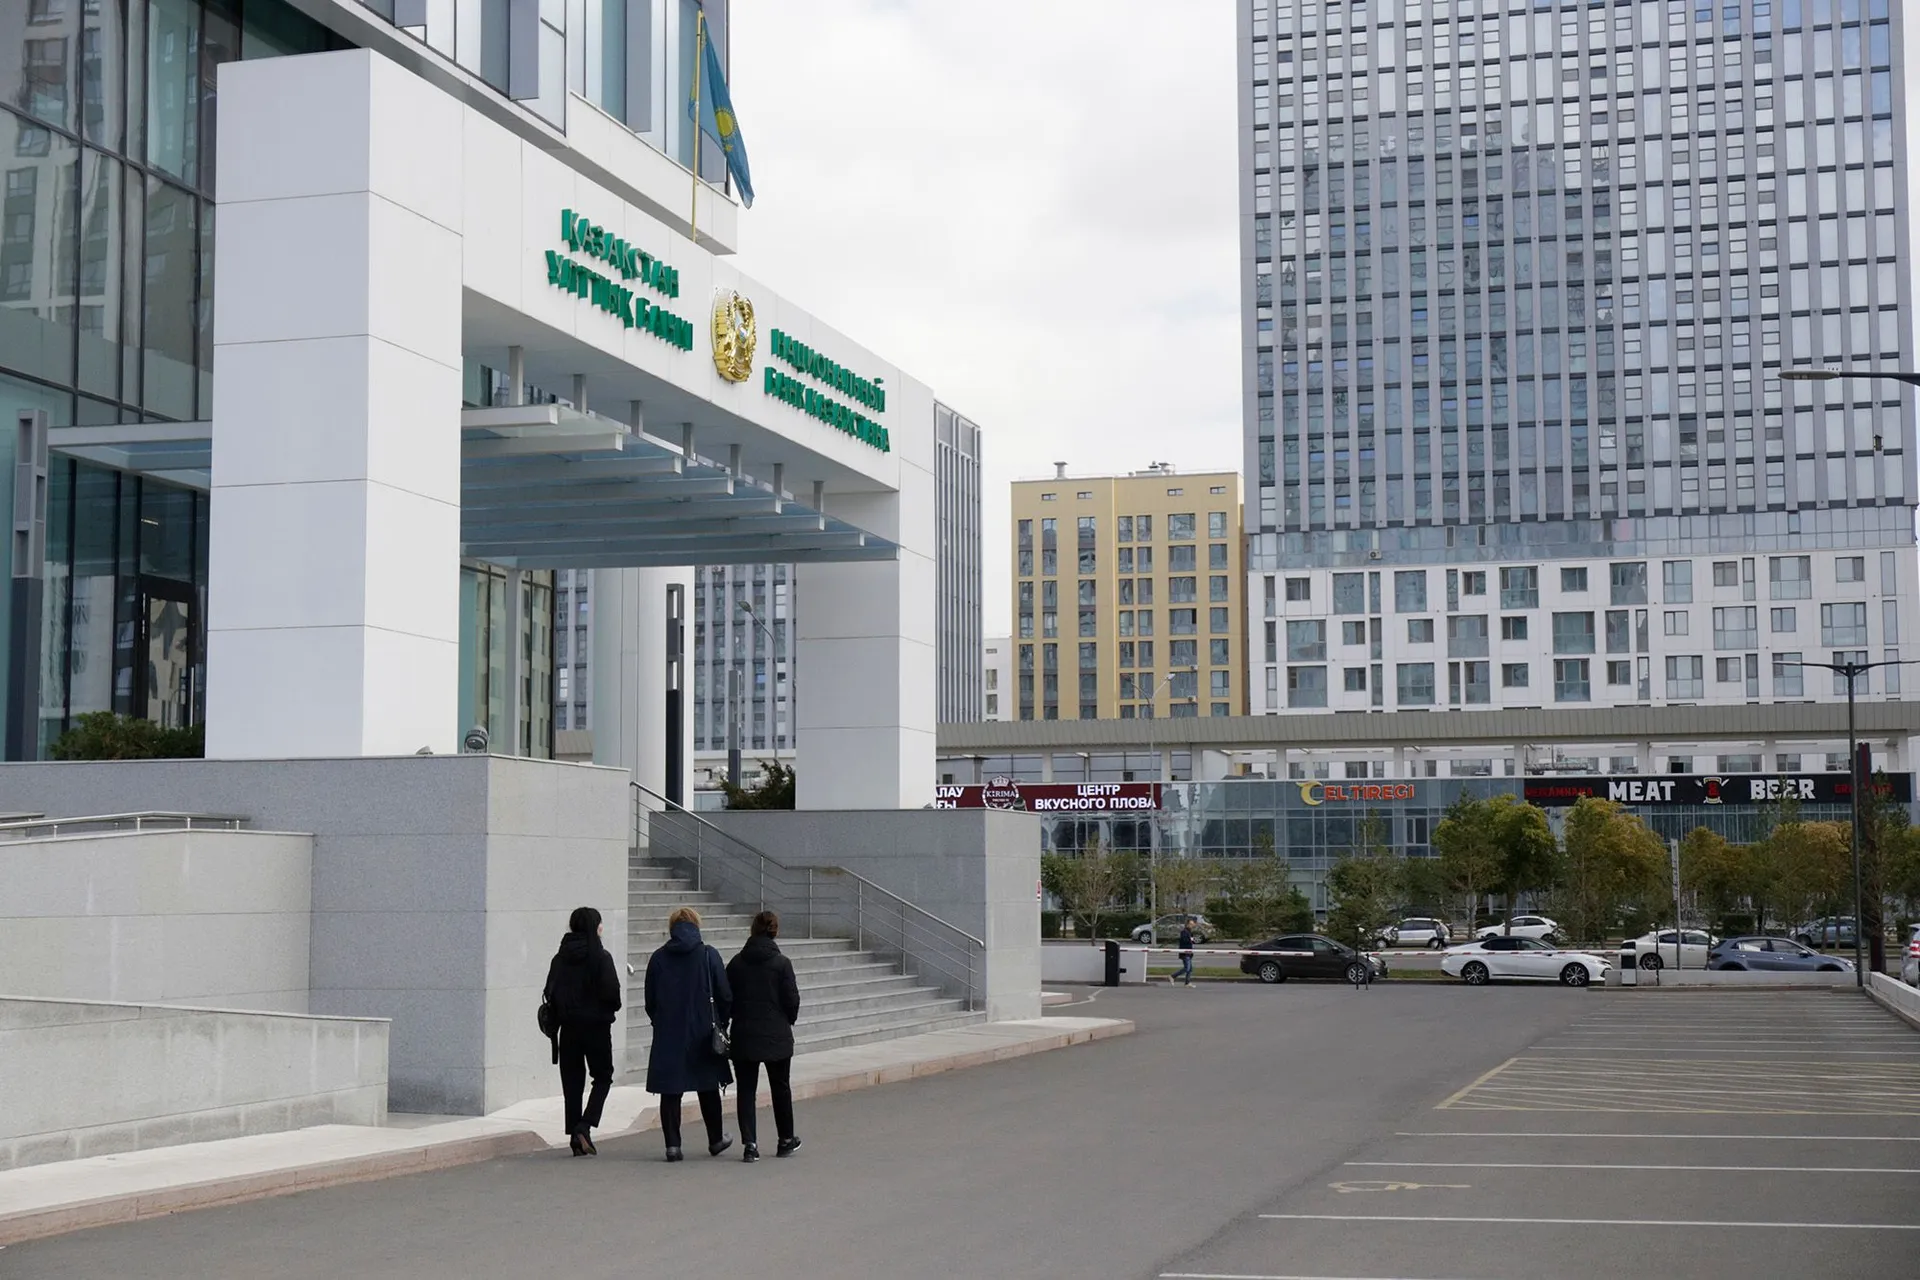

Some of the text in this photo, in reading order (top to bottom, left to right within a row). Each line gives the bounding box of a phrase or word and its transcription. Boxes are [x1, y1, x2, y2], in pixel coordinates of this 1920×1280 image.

[771, 328, 885, 413] НАЦИОНАЛЬНЫЙ
[764, 367, 890, 453] БАНК КАЗАХСТАНА
[1077, 784, 1121, 798] ЦЕНТР
[1324, 784, 1415, 800] EL TIREGI
[1608, 781, 1675, 801] MEAT
[1750, 779, 1816, 800] BEER
[1034, 797, 1157, 810] ВКУСНОГО ПЛОВА
